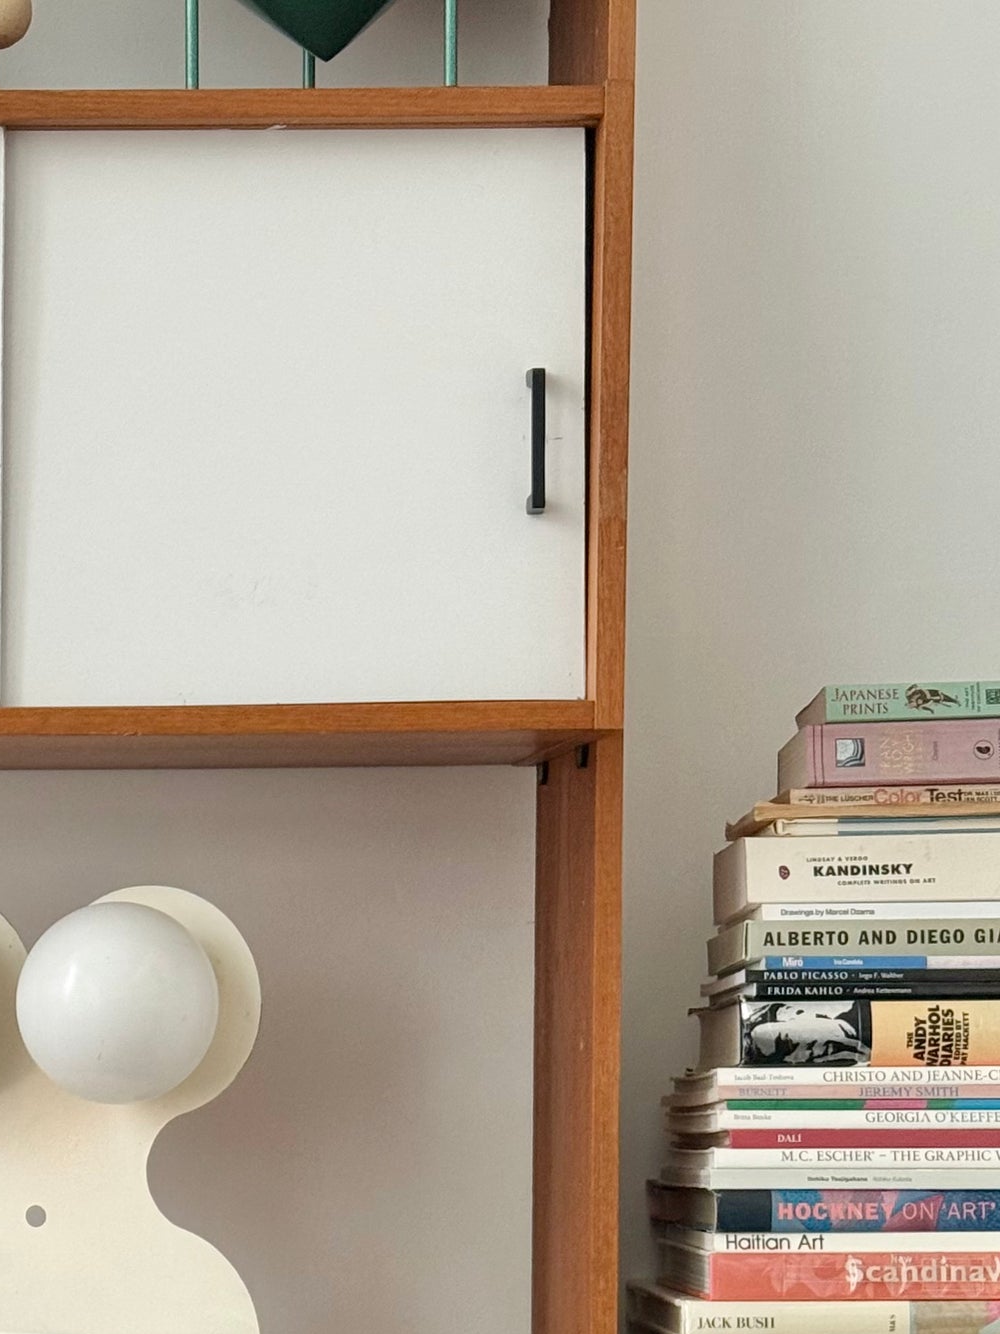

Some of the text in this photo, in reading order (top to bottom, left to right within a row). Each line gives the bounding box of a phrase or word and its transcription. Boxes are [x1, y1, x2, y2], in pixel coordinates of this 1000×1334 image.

[831, 687, 899, 702] JAPANESE
[843, 703, 888, 716] PRINTS
[873, 788, 964, 805] Color Test
[813, 863, 913, 877] KANDINSKY
[780, 908, 814, 917] Drawings
[815, 908, 824, 917] by
[825, 908, 849, 916] Marcel
[763, 929, 965, 947] ALBERTO AND DIEGO
[763, 971, 848, 980] PABLO PICASSO
[767, 987, 843, 995] FRIDA KAHLO
[940, 1008, 954, 1066] DIARIES
[961, 1011, 969, 1050] HACKETT
[913, 1016, 926, 1061] ANDY
[954, 1019, 962, 1061] EDITED BY
[823, 1070, 923, 1082] CHRISTO AND
[739, 1086, 960, 1097] BURNETT JEREMY SMITH
[865, 1111, 931, 1123] GEORGIA
[781, 1150, 992, 1162] M.C. THE GRAPHIC
[778, 1202, 934, 1220] HOCKNEY ON
[725, 1234, 825, 1250] Haitian Art
[697, 1316, 775, 1329] JACK BUSH
